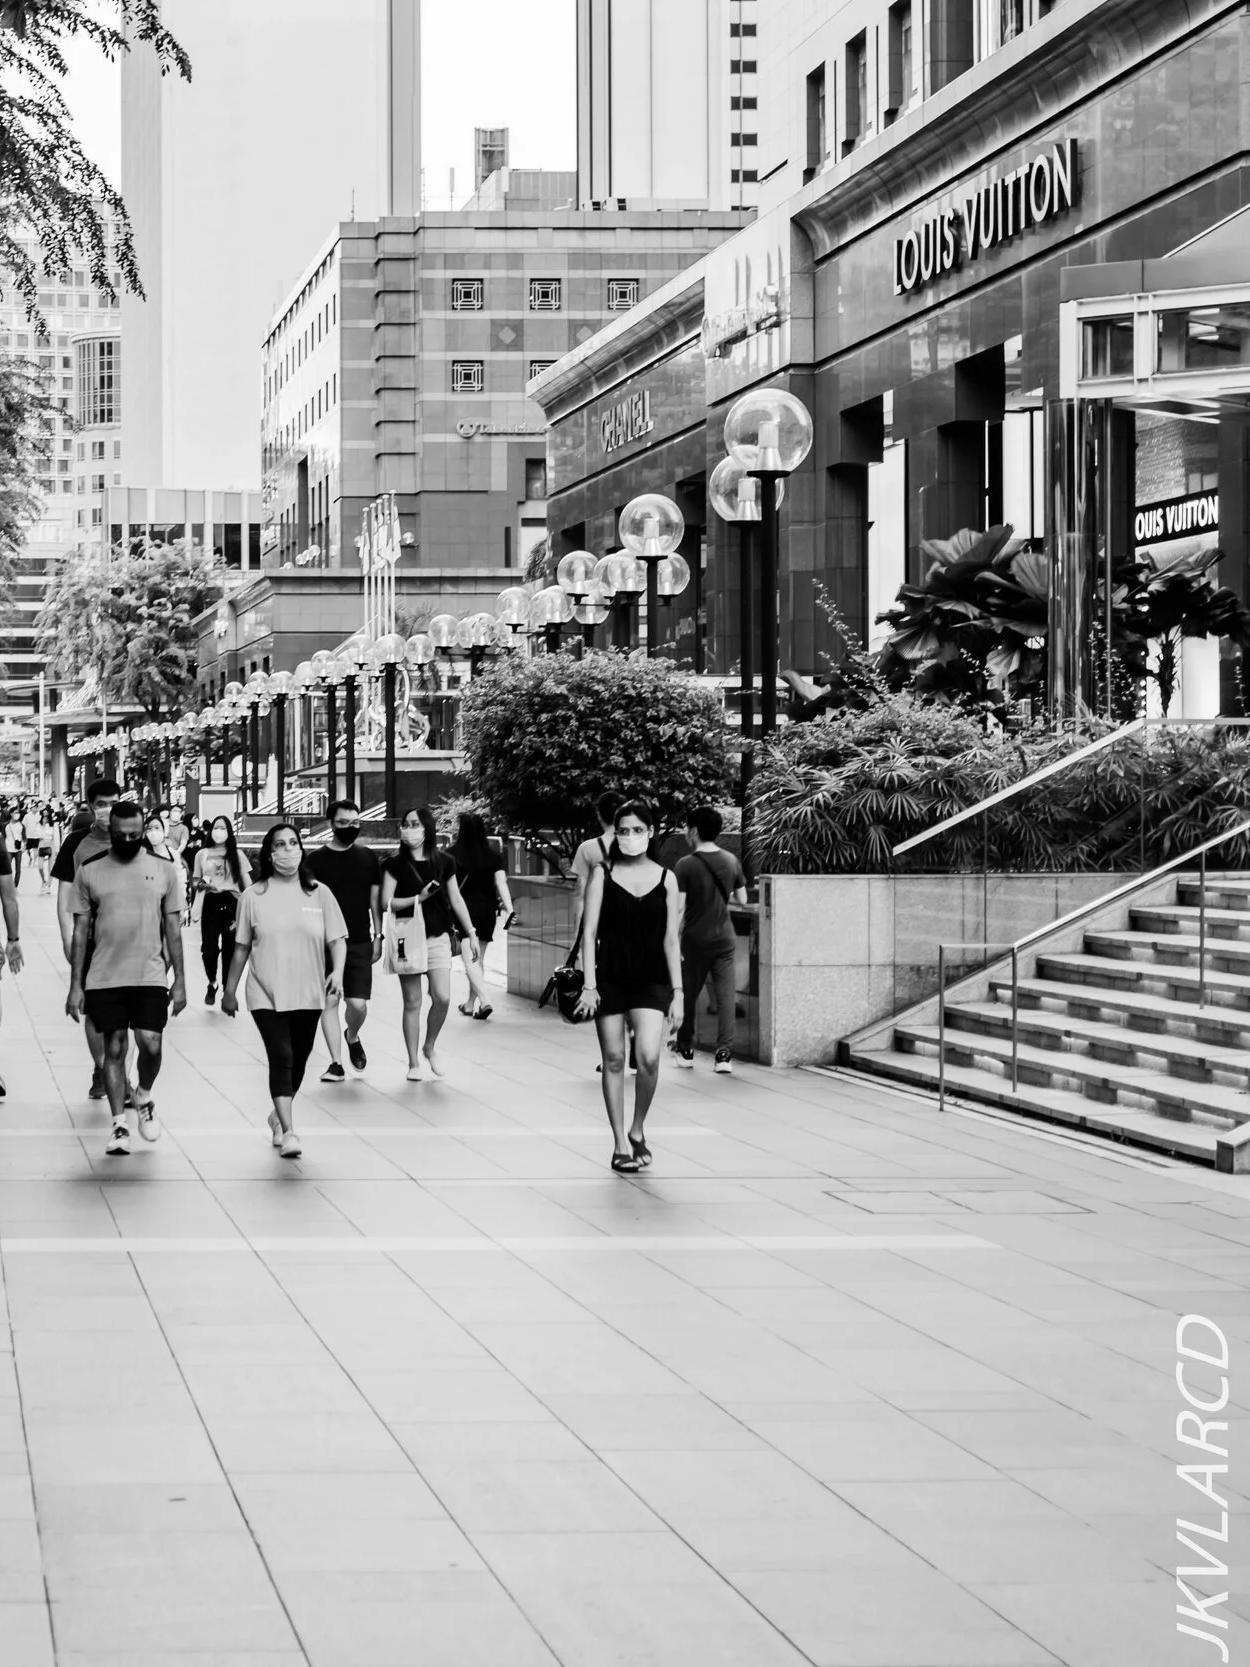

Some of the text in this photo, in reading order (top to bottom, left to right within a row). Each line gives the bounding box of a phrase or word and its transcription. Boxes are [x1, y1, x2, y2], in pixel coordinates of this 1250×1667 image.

[894, 138, 1077, 296] LOUIS VUITTON
[601, 390, 653, 453] CHANEL
[1135, 495, 1219, 540] OUIS VUITTON
